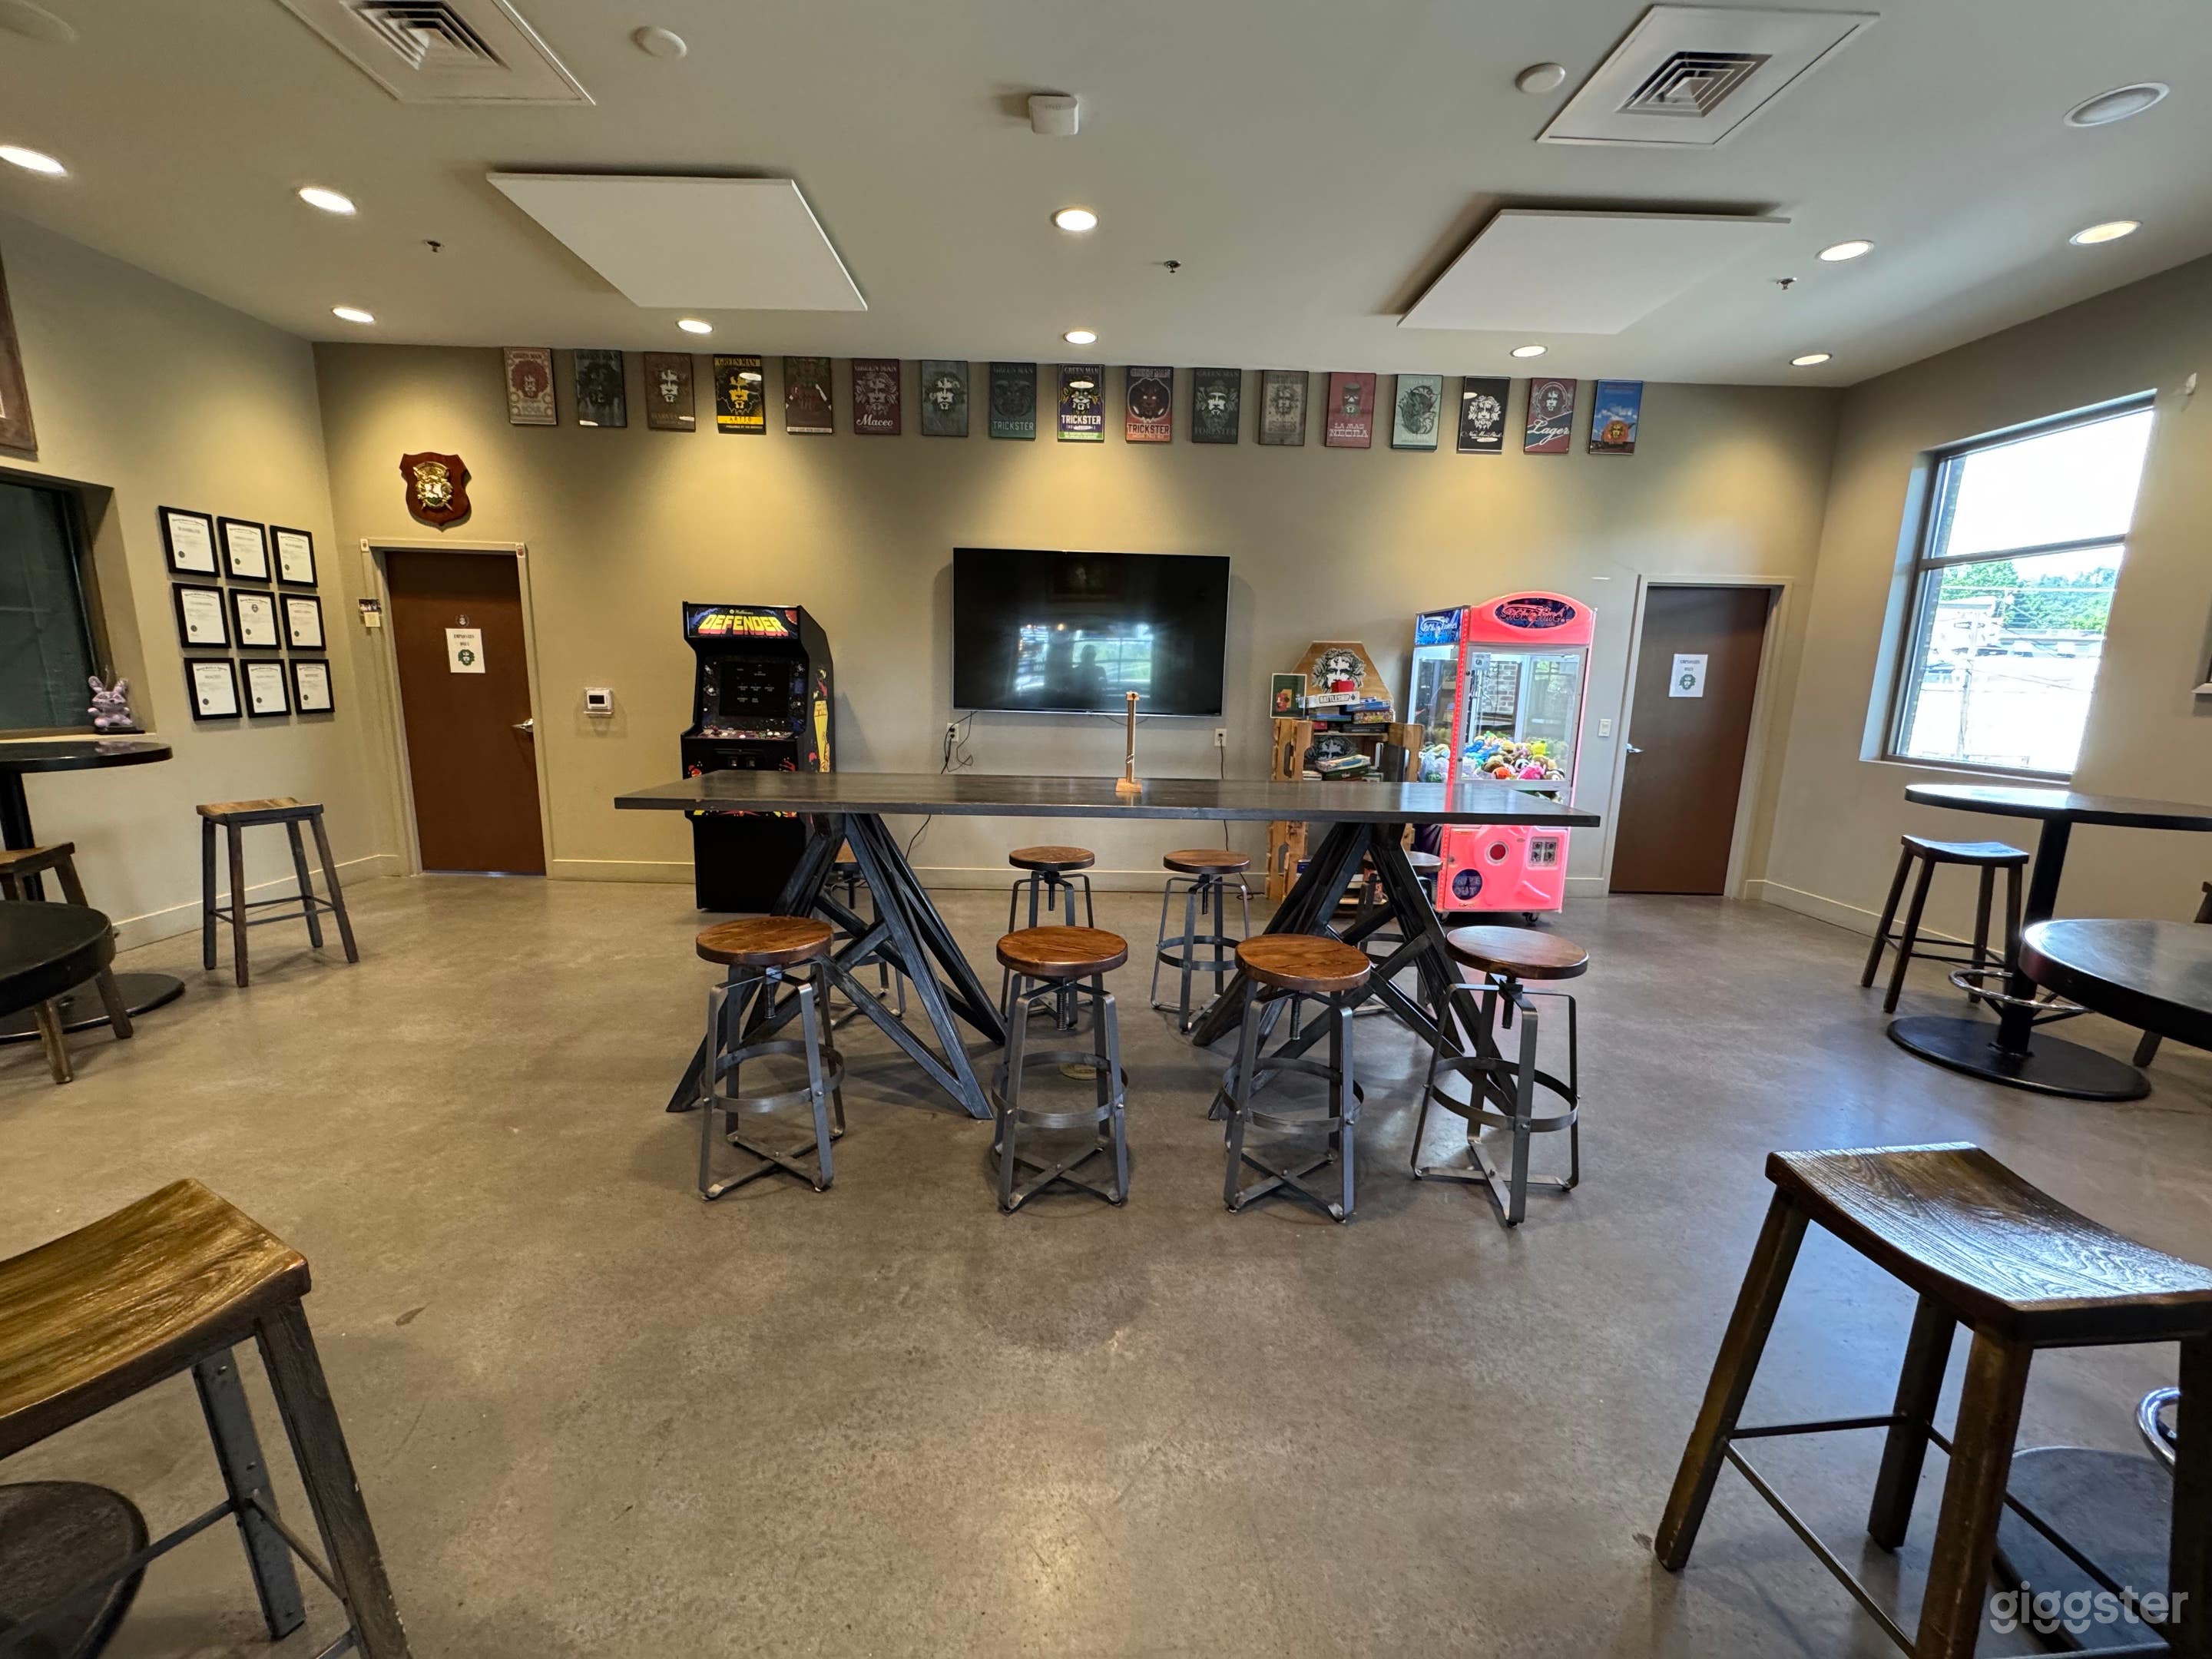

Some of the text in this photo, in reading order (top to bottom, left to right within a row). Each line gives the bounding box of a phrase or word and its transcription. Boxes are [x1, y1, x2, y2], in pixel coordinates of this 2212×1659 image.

[1061, 415, 1101, 425] TRICKSTER
[993, 421, 1034, 431] TRICKSTER
[1128, 424, 1169, 434] TRICKSTER
[1527, 419, 1570, 445] Lager
[698, 614, 789, 637] DEFENDER
[1320, 694, 1350, 704] BATTLESHIP
